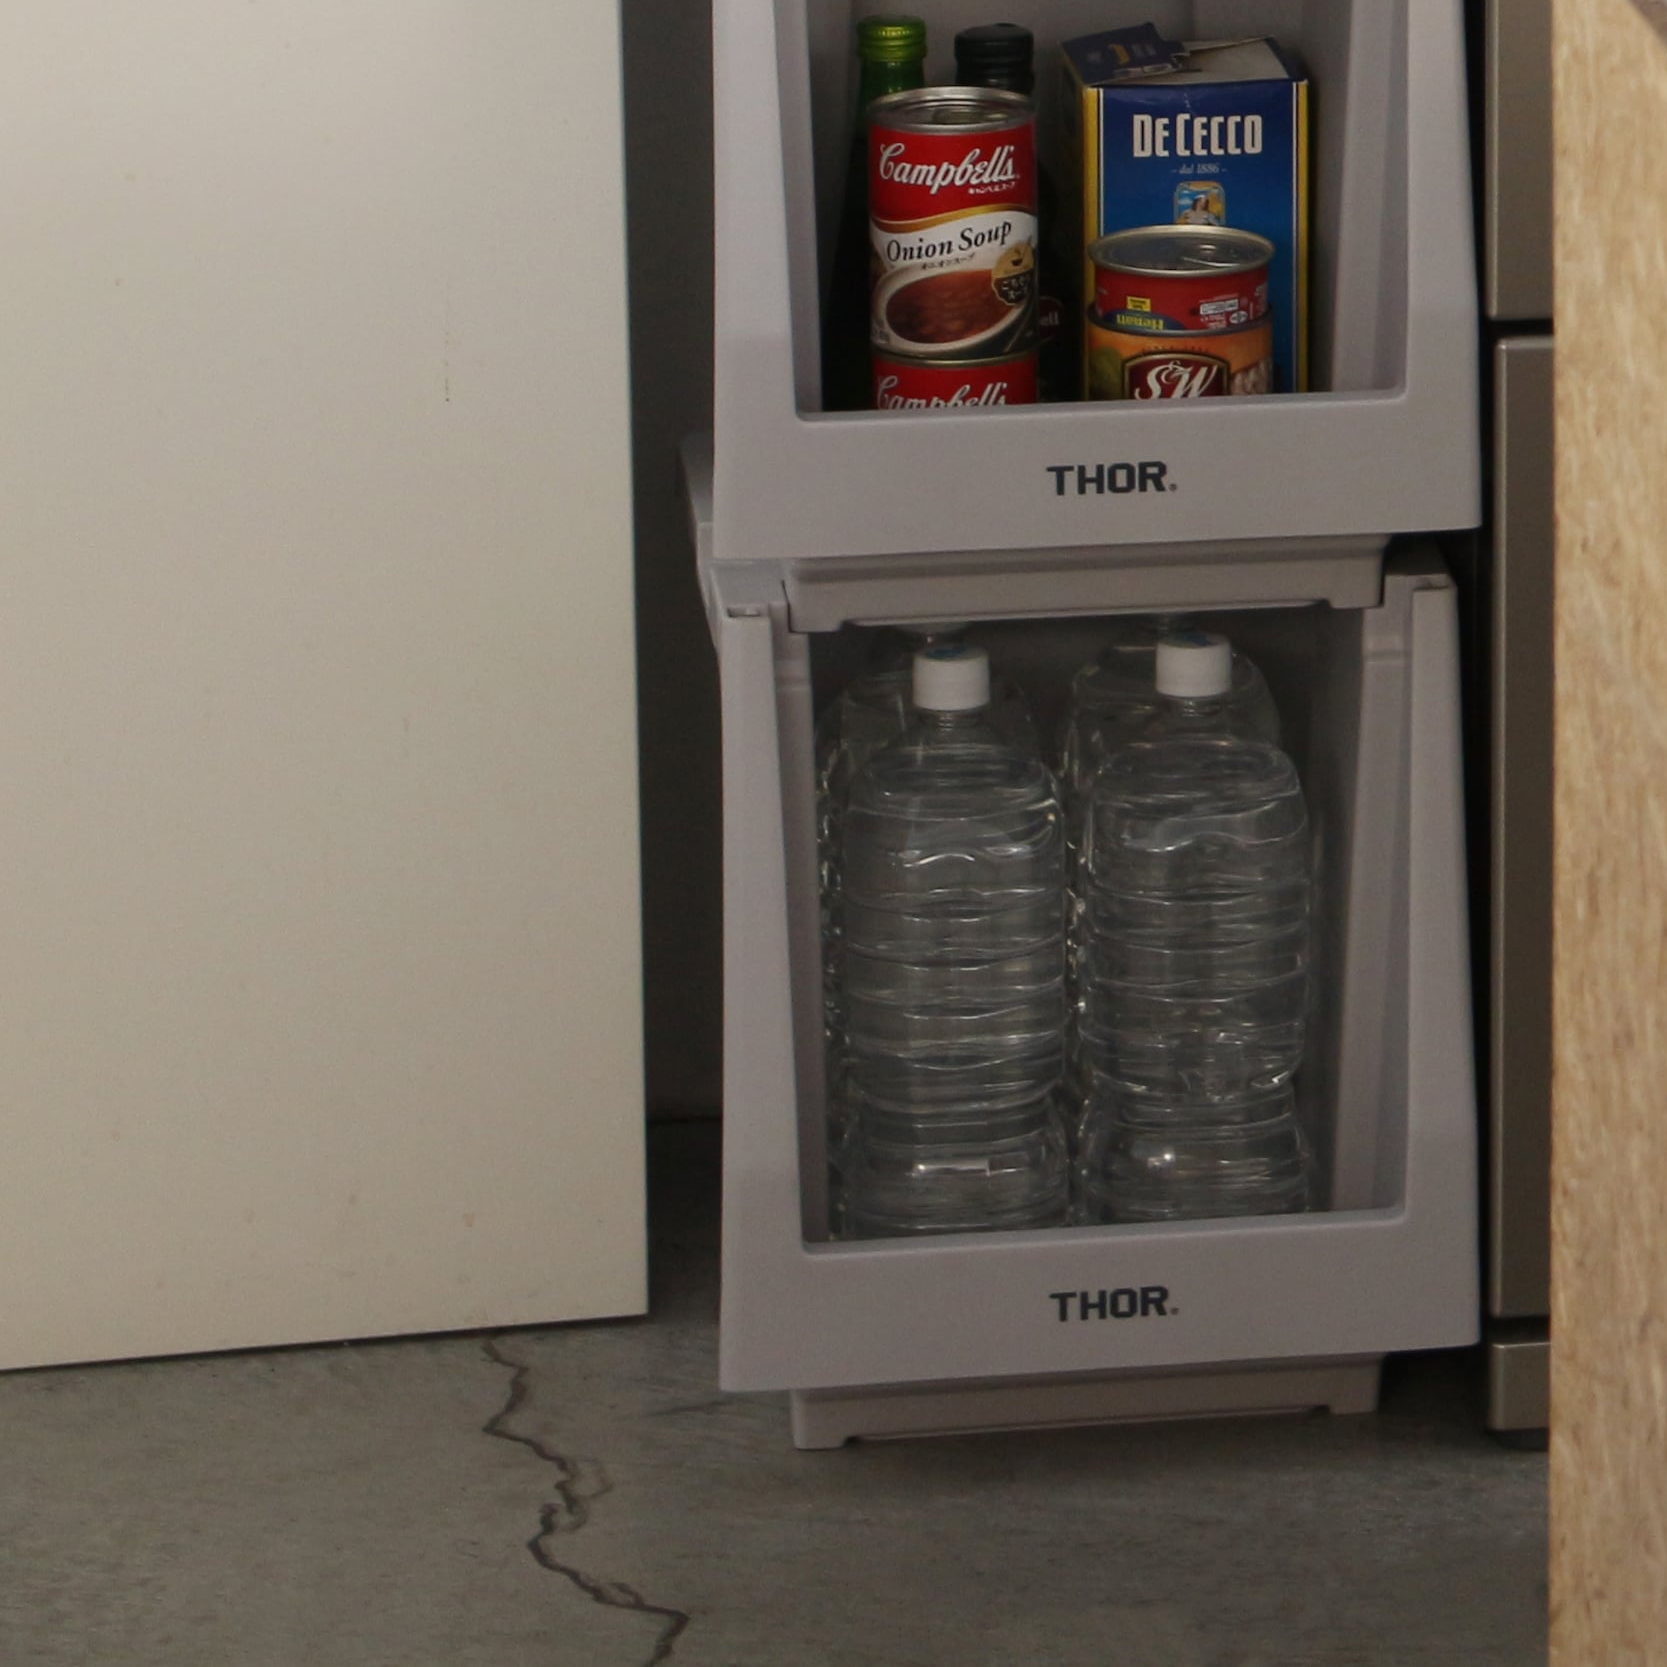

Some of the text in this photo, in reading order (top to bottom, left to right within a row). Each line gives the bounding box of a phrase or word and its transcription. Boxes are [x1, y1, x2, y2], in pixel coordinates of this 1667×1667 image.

[1133, 113, 1263, 157] DE CECCO
[879, 142, 1016, 195] Campbell's
[886, 221, 1012, 262] Onion Soup
[1046, 461, 1167, 496] THOR
[1048, 1286, 1169, 1322] THOR
